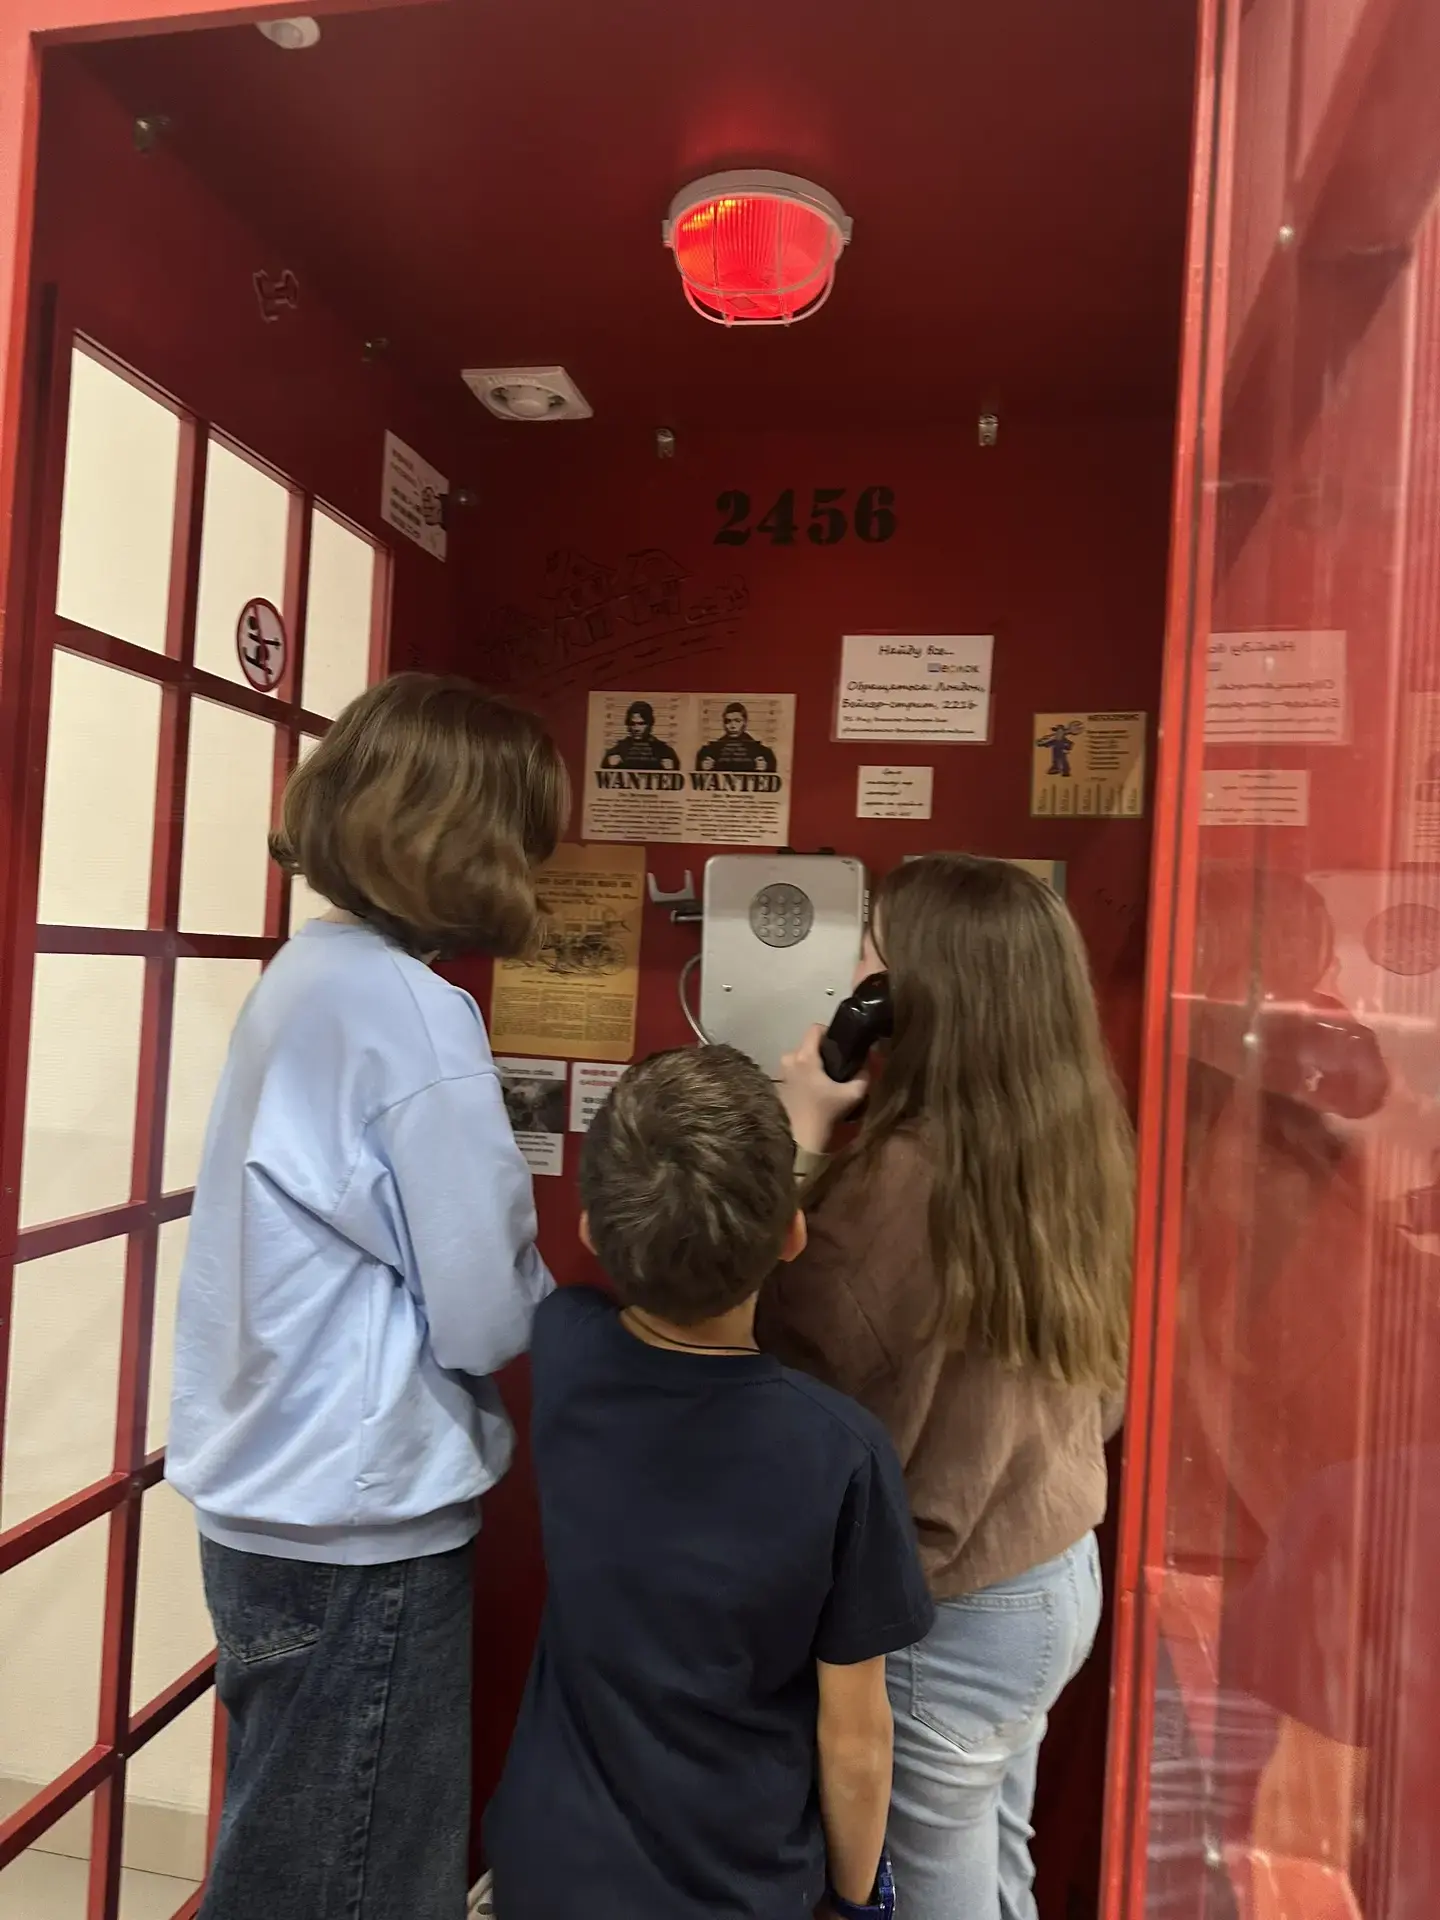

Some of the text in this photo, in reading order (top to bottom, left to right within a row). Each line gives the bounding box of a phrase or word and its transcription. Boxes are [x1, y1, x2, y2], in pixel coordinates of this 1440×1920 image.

[713, 486, 898, 546] 2456
[595, 770, 685, 791] WANTED
[689, 772, 782, 793] WANTED
